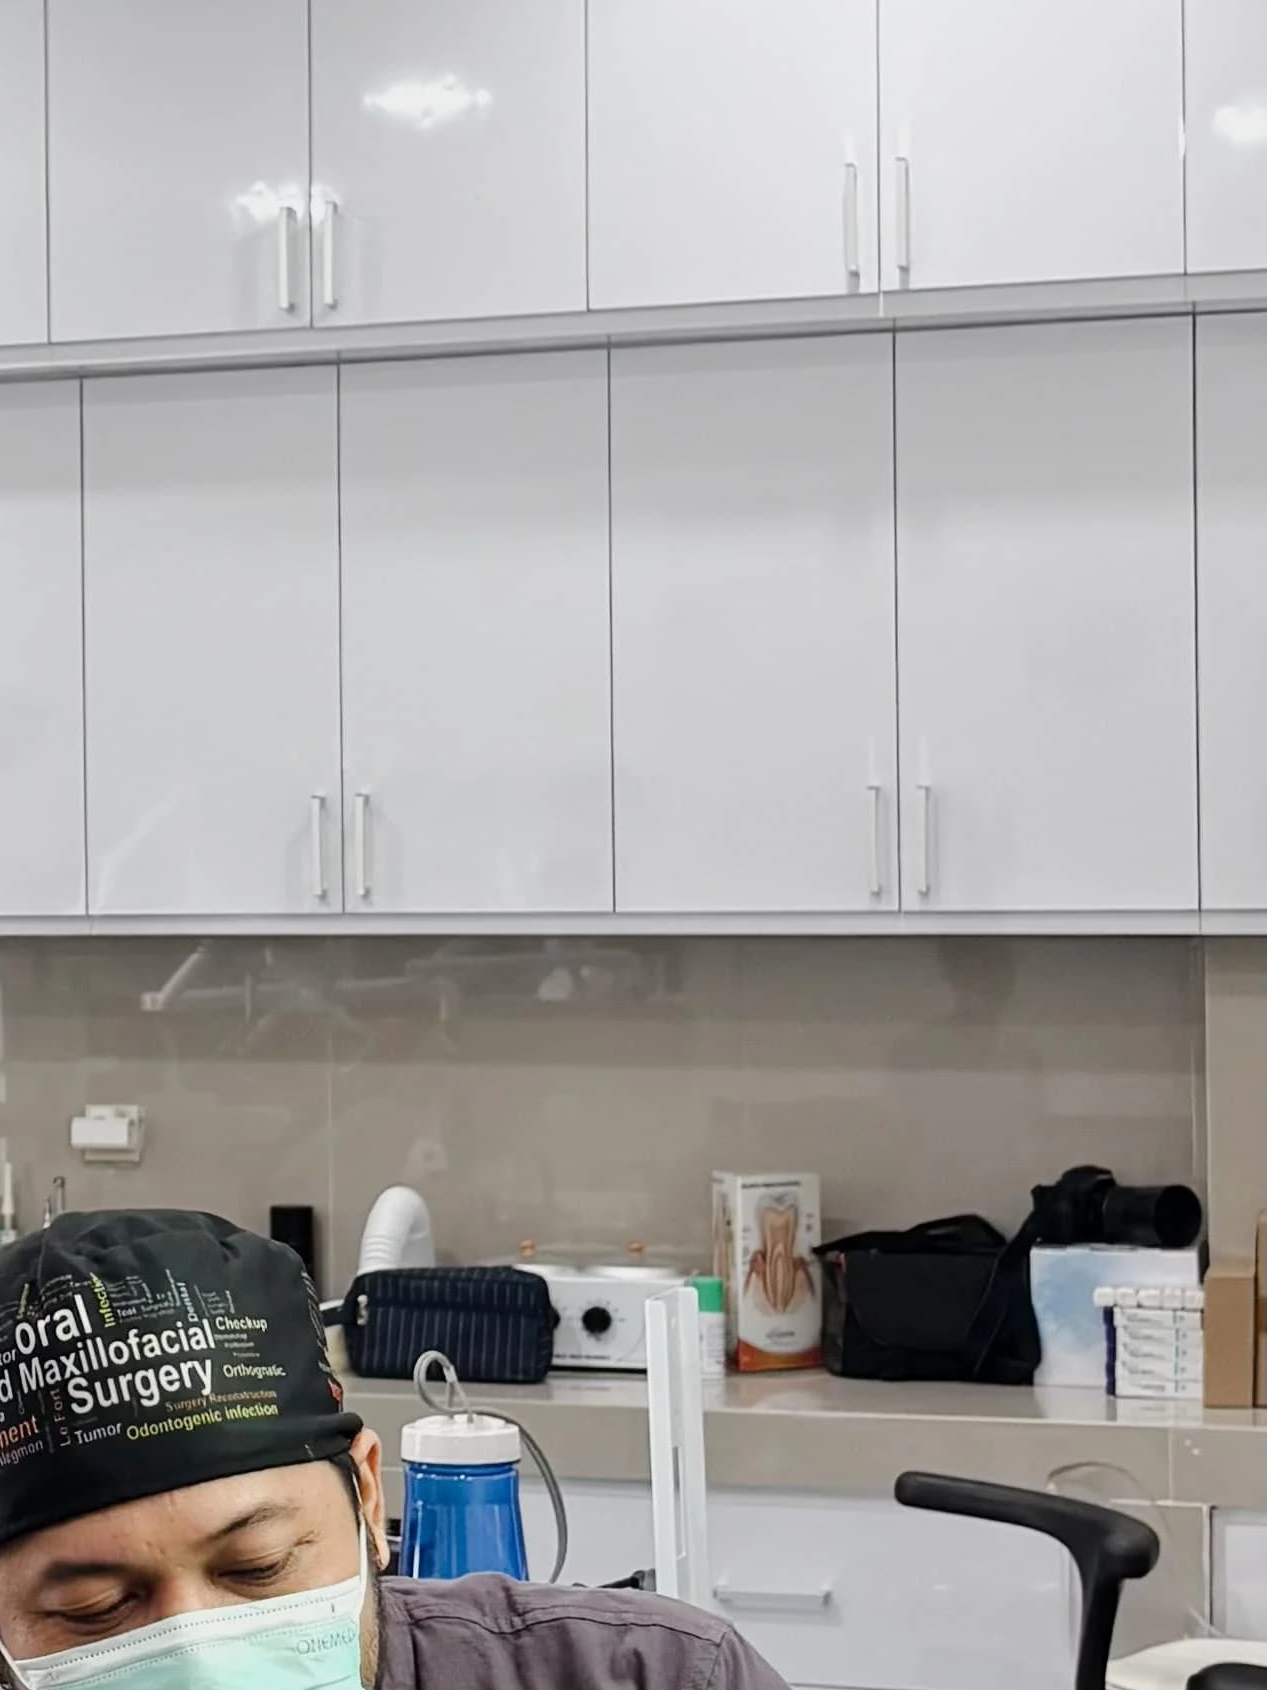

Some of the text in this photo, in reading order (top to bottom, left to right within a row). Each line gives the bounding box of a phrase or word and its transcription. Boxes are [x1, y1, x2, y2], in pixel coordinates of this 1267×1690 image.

[215, 1316, 268, 1332] Checkup
[18, 1318, 216, 1395] Maxillofacial
[67, 1359, 212, 1415] Surgery
[73, 1421, 122, 1444] Tumor
[126, 1408, 224, 1440] Odontogenic
